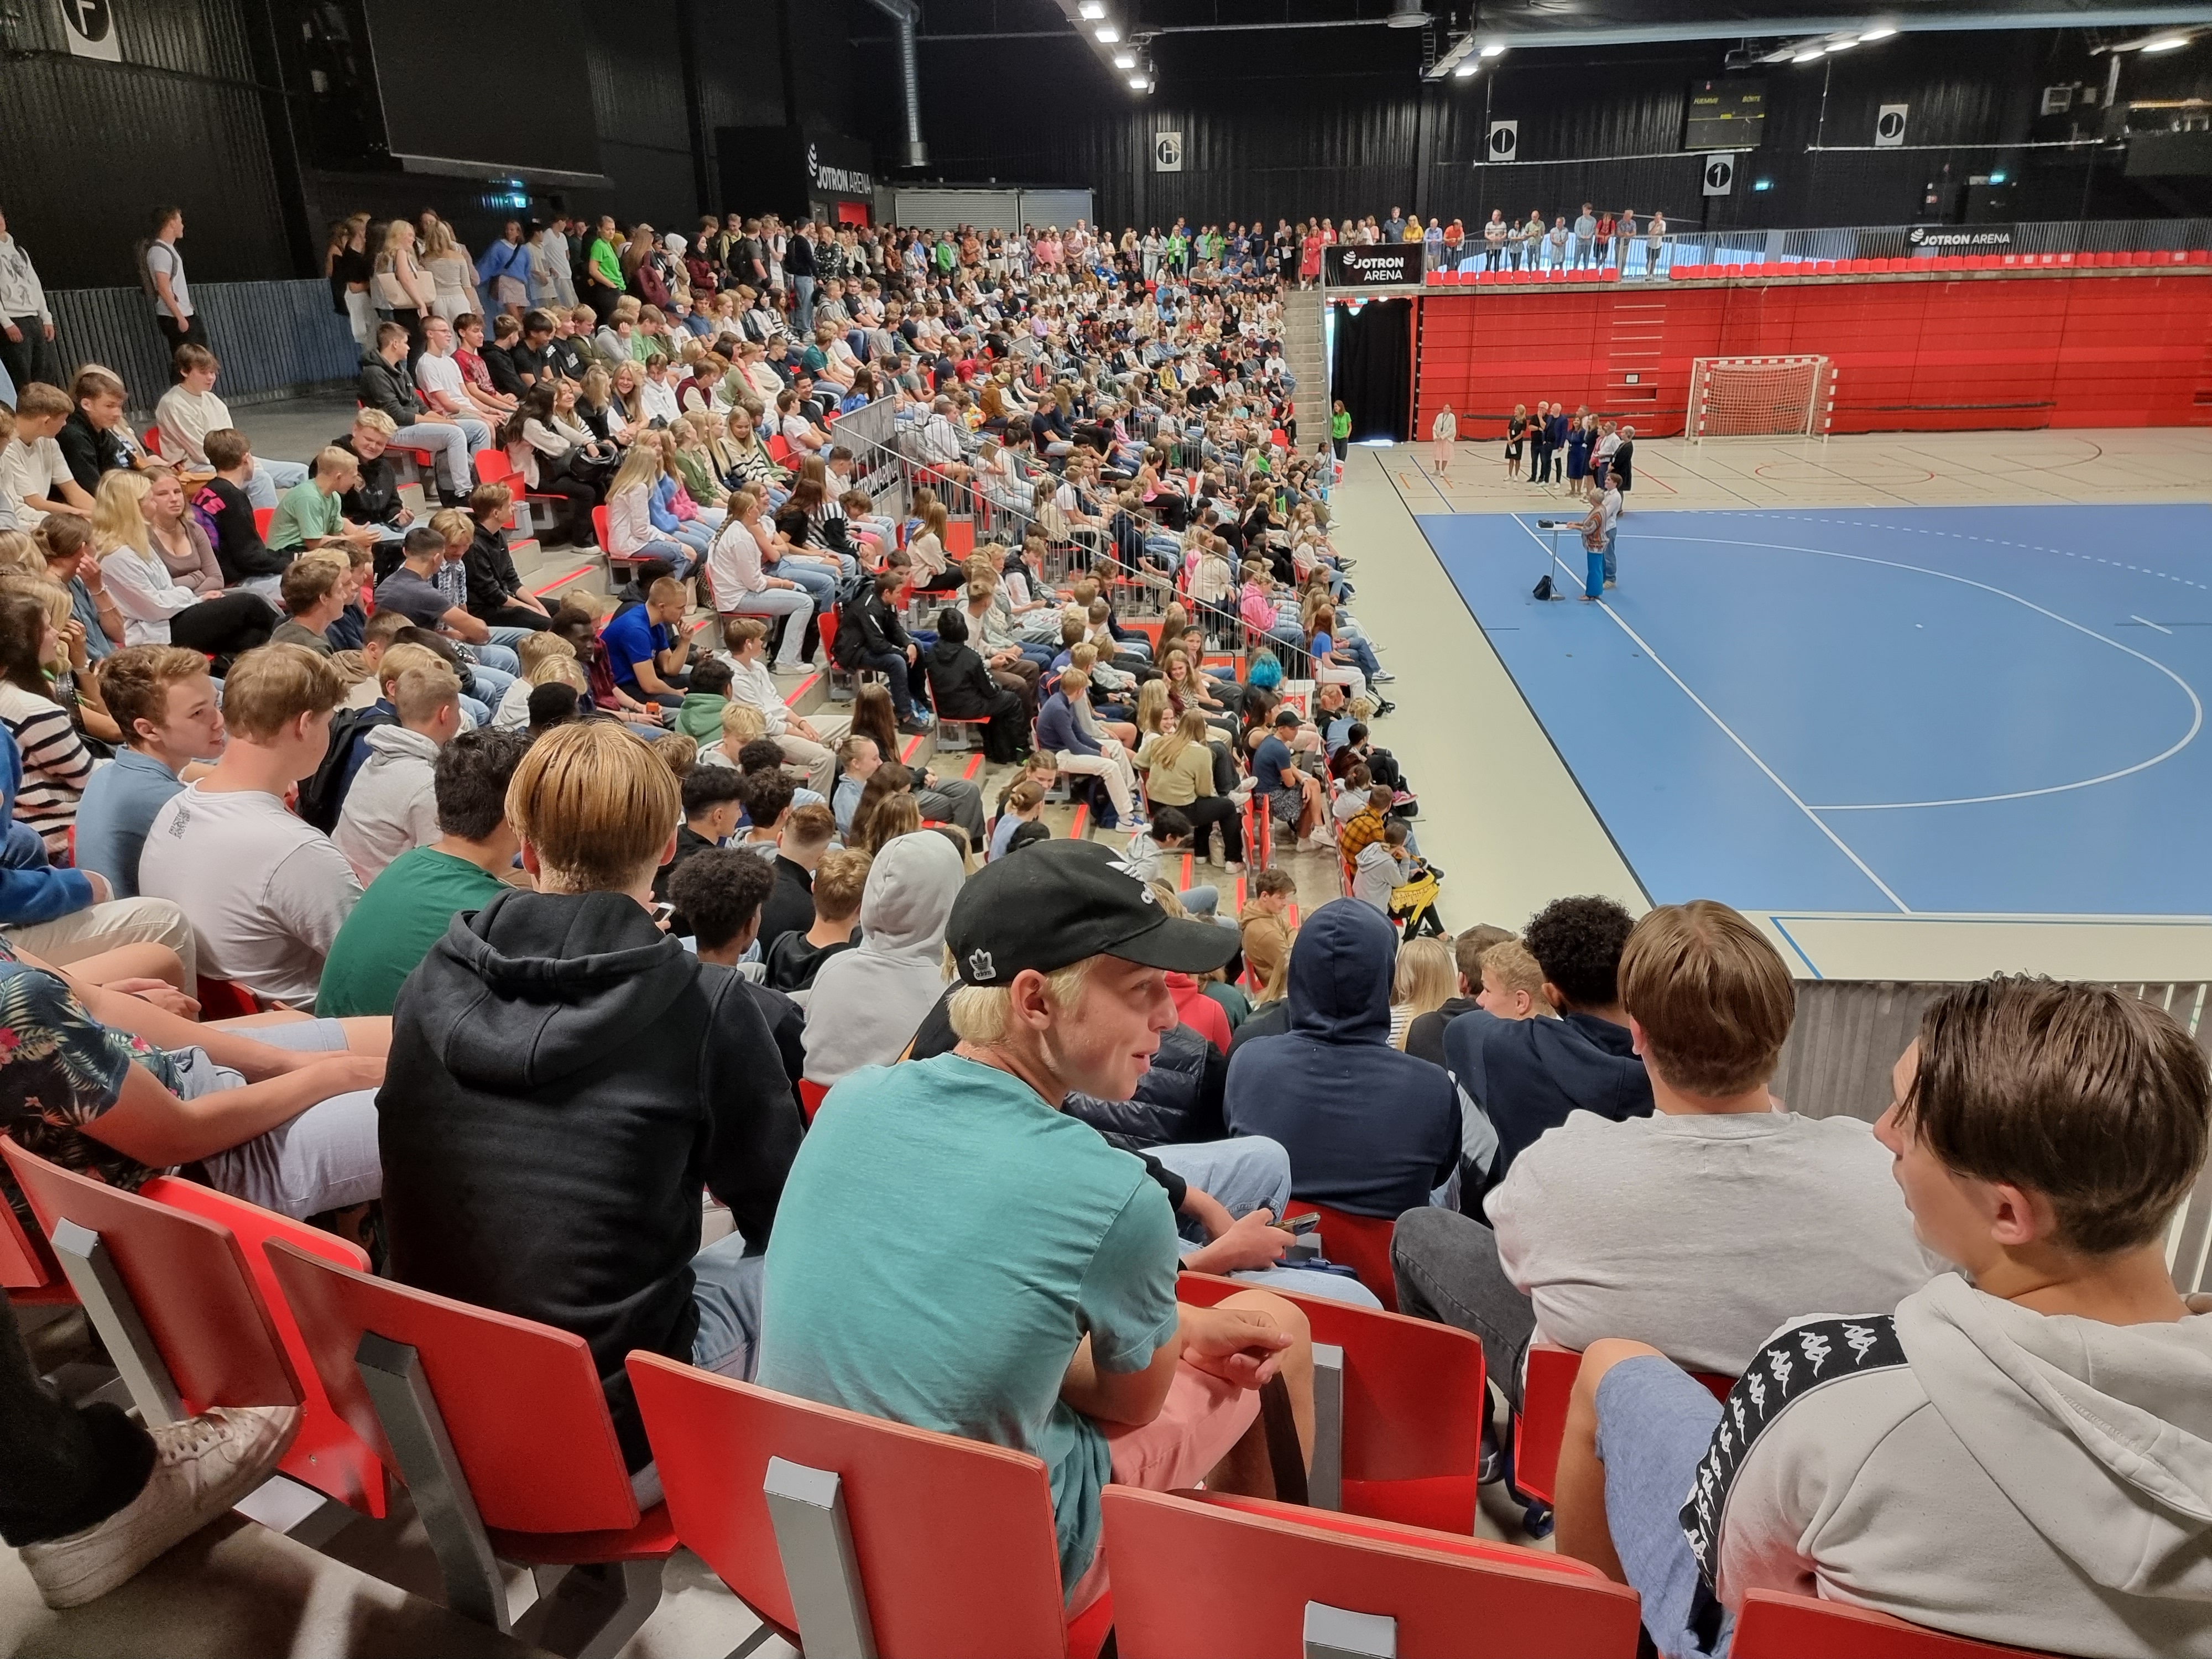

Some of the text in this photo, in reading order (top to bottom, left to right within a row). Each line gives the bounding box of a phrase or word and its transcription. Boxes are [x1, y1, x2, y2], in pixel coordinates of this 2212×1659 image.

[1885, 115, 1897, 137] J
[1163, 142, 1175, 163] H
[1501, 132, 1506, 153] I
[817, 165, 872, 195] JOTRON ARENA
[1714, 165, 1722, 187] 1
[1920, 232, 2010, 246] JOTRON ARENA
[1353, 257, 1404, 269] JOTRON
[1364, 269, 1403, 281] ARENA
